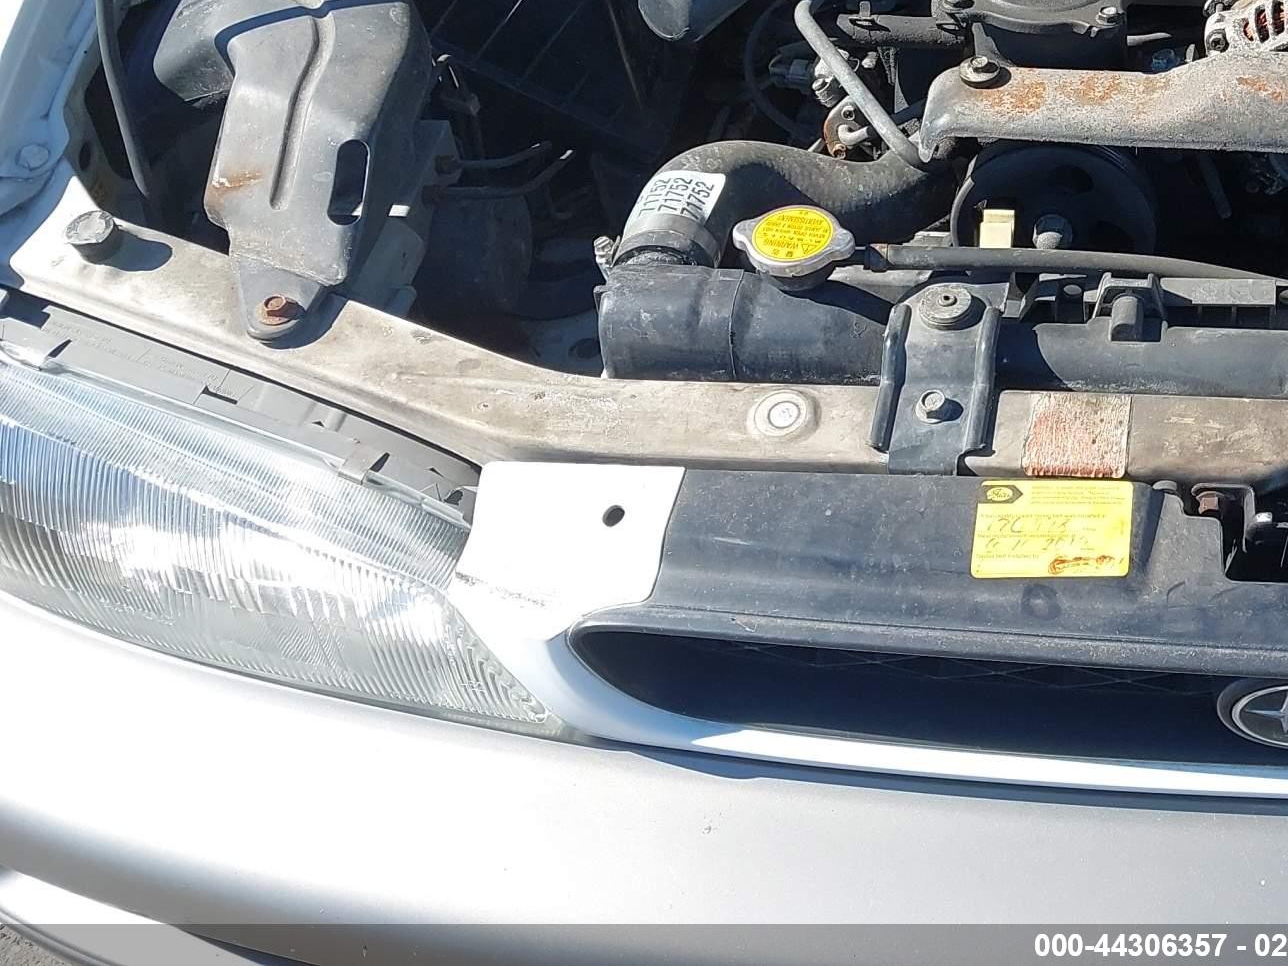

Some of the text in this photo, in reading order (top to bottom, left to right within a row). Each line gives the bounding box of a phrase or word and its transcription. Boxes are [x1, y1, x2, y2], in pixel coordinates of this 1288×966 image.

[637, 177, 672, 219] 71752
[657, 177, 694, 212] 71752
[680, 181, 716, 220] 71752
